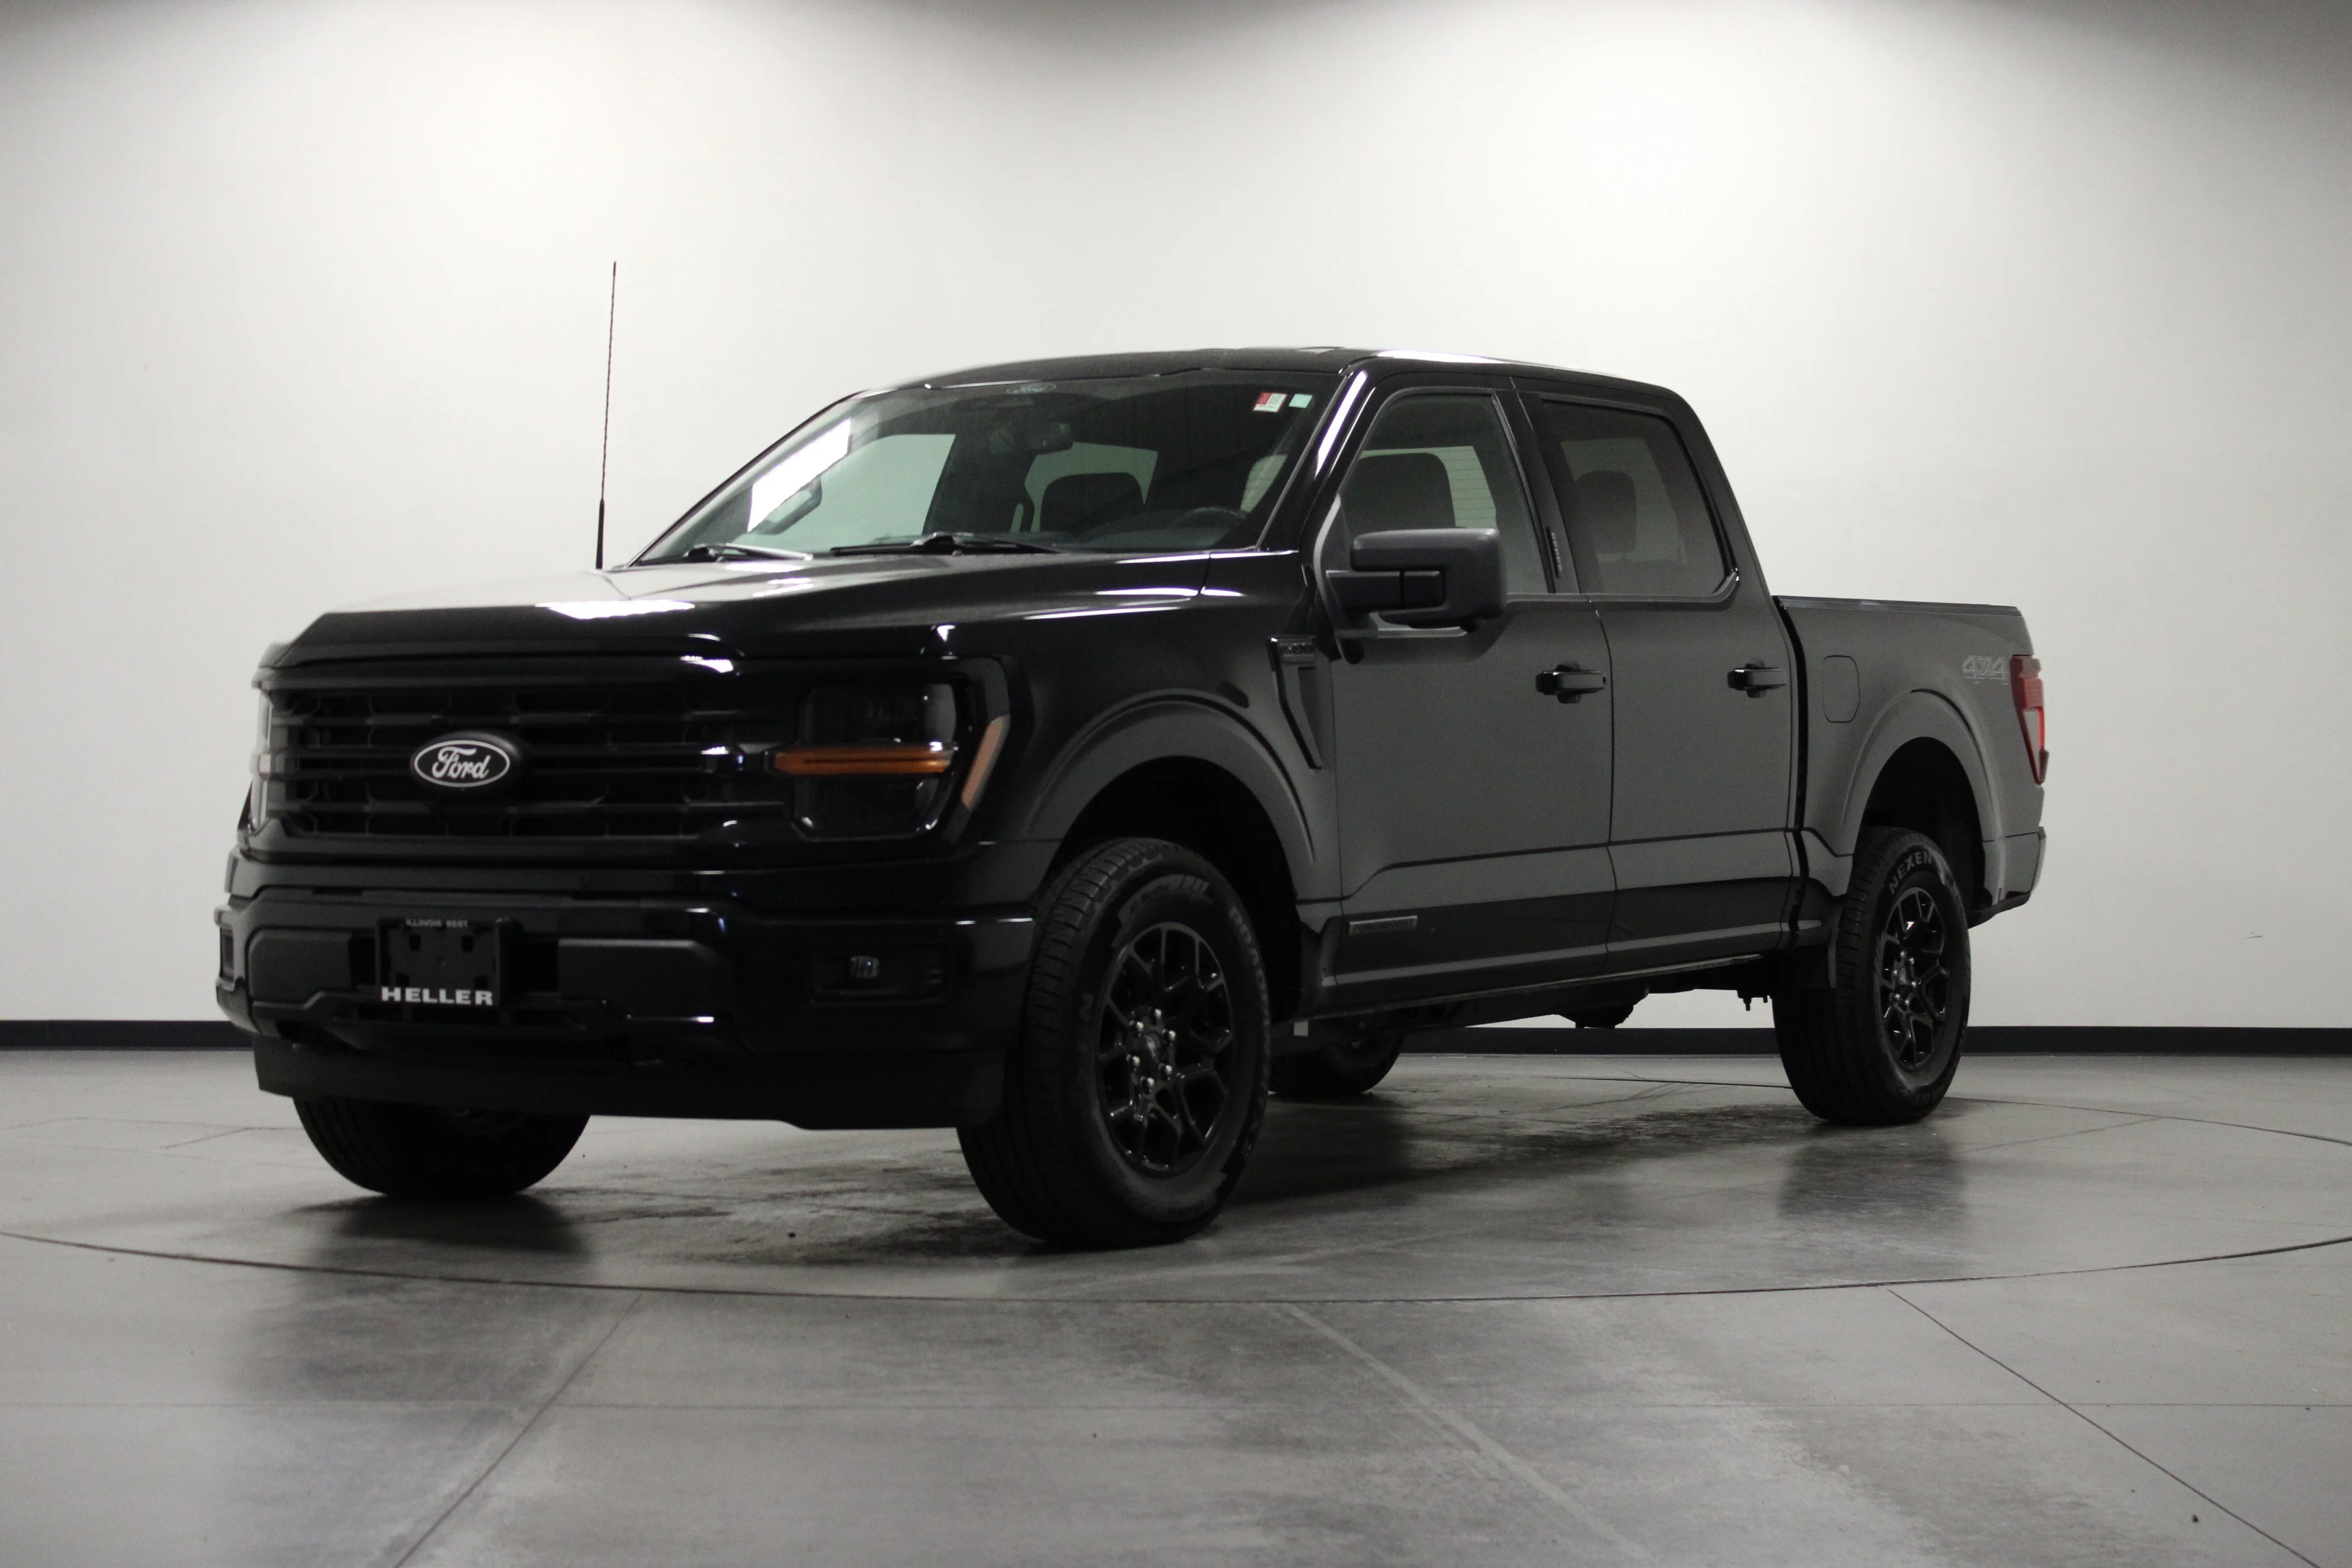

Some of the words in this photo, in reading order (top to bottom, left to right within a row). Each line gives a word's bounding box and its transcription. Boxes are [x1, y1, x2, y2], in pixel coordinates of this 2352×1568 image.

[432, 746, 491, 779] Ford
[1889, 851, 1932, 894] NEXEN
[381, 986, 493, 1006] HELLER
